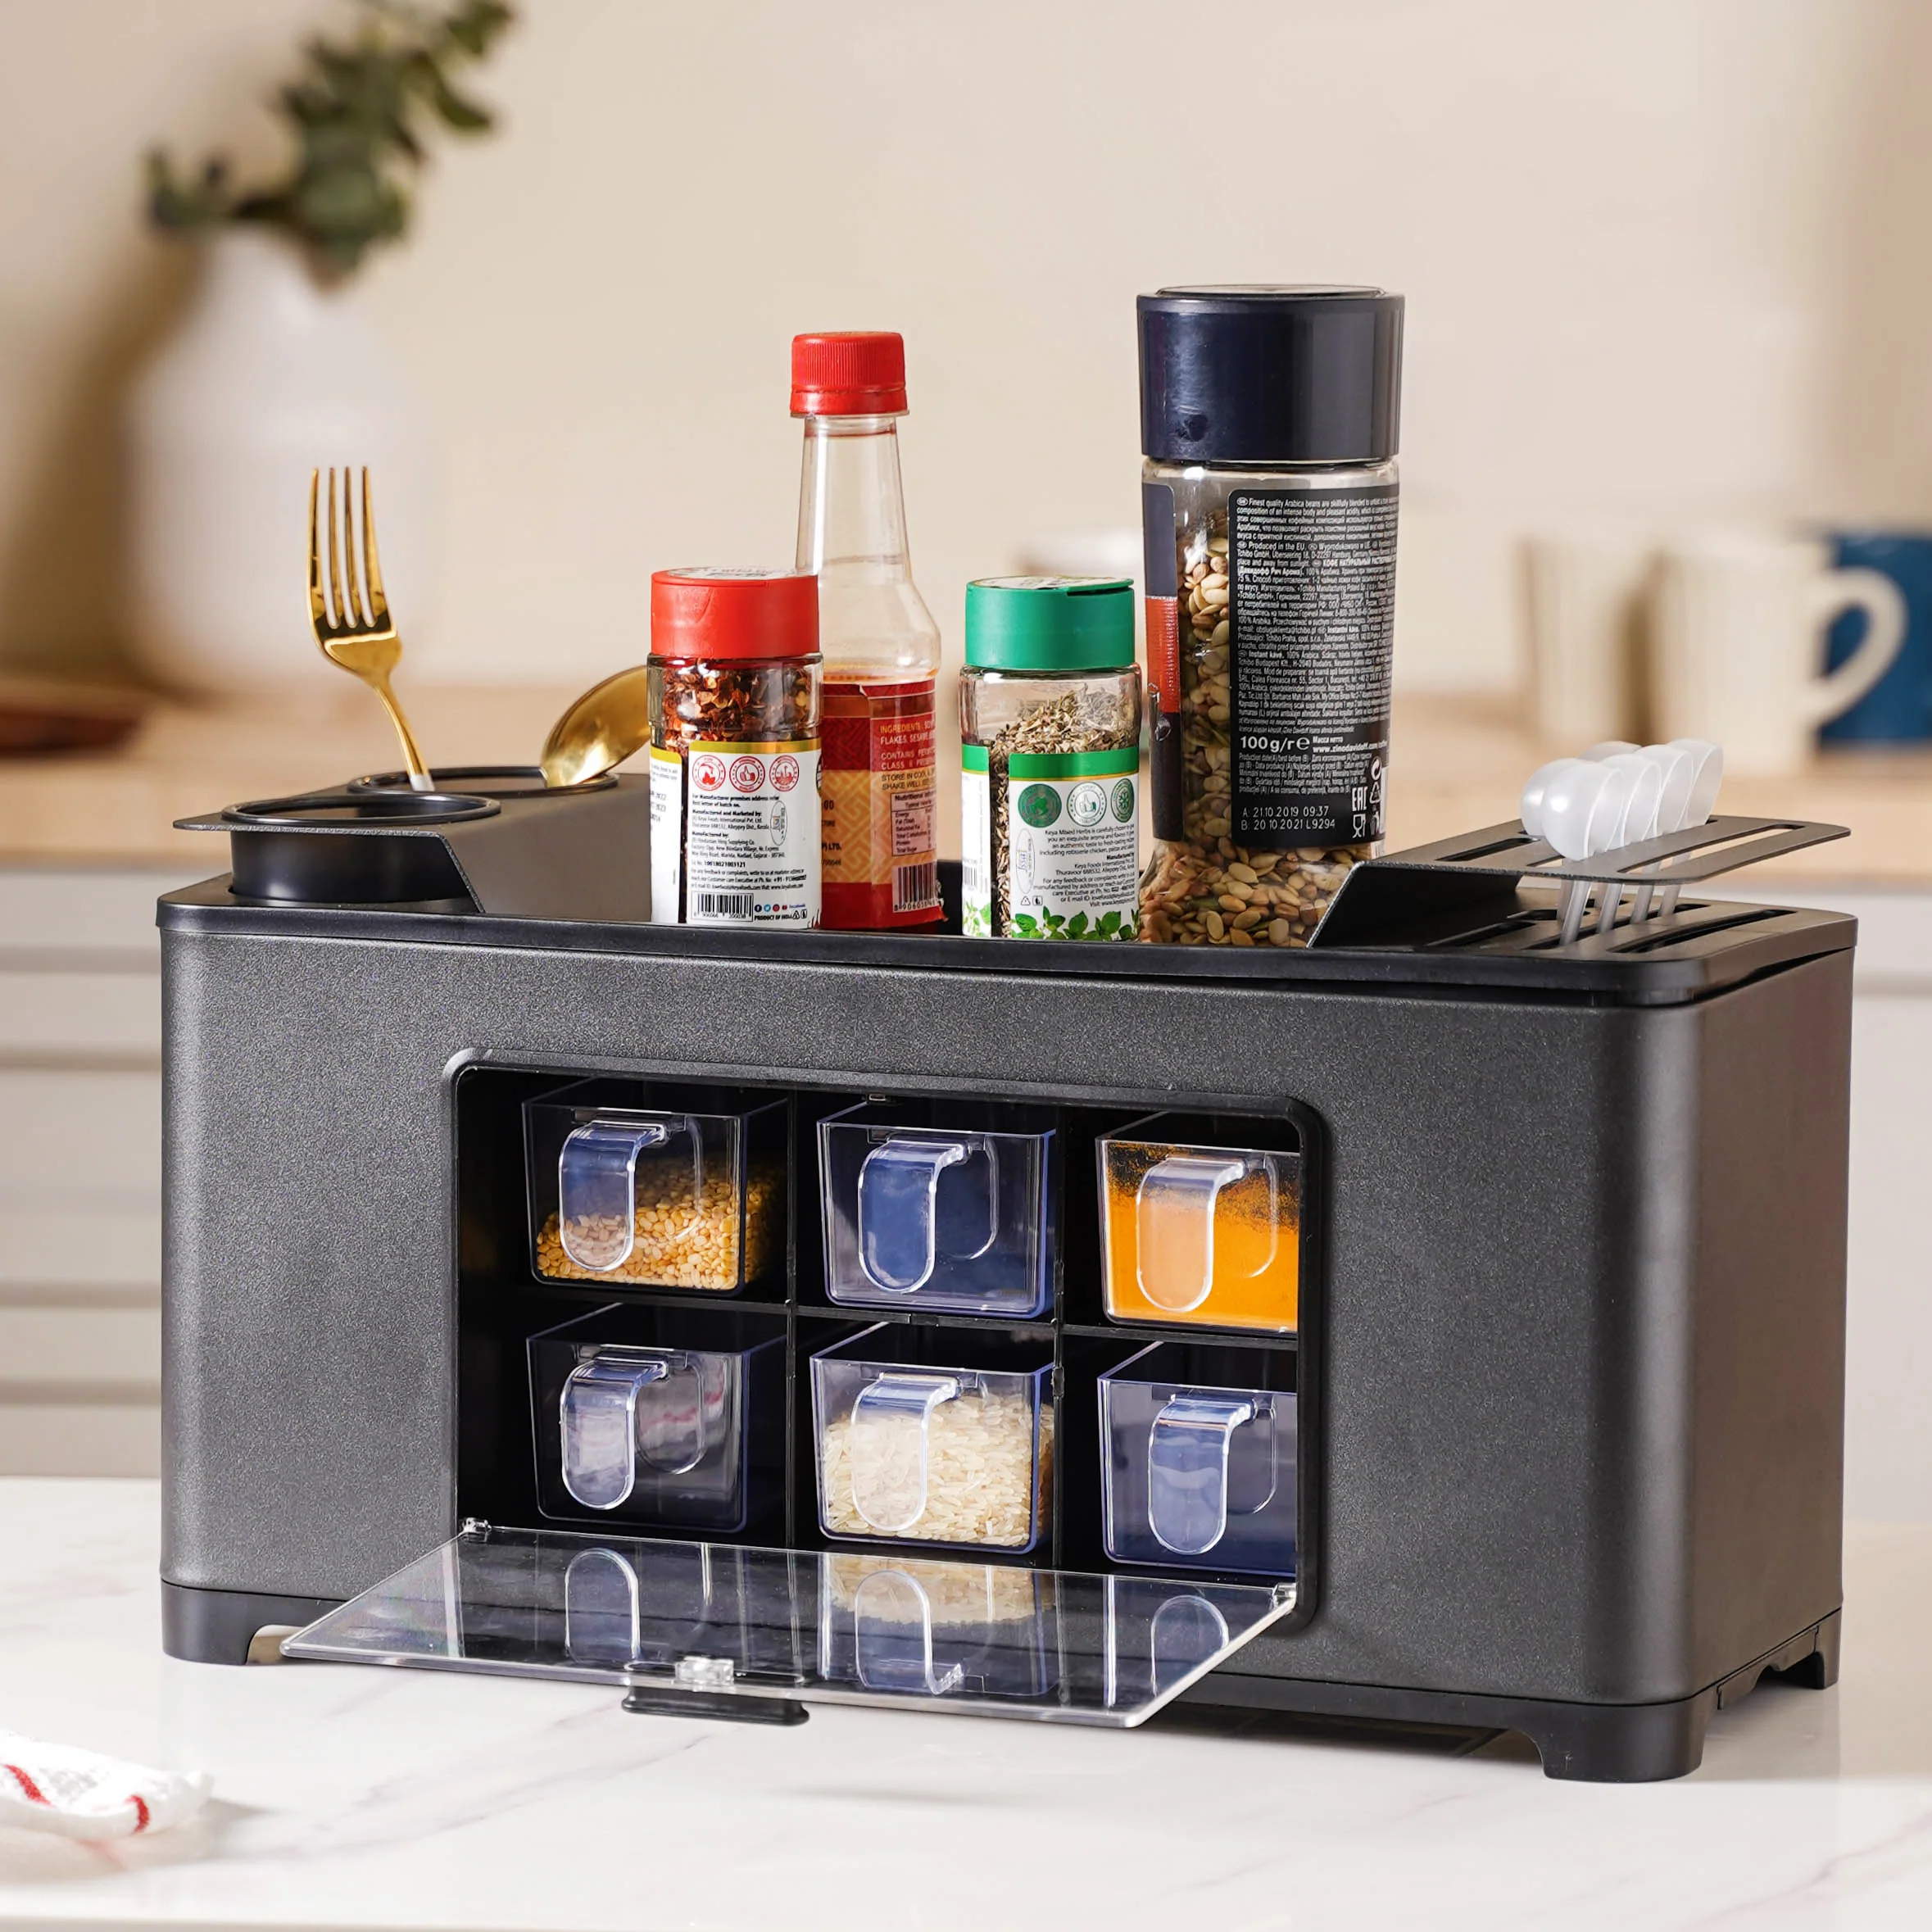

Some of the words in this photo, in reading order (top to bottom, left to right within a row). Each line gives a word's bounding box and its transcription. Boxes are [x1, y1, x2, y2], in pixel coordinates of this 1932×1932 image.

[1249, 542, 1277, 550] Produced
[1237, 549, 1253, 557] Tchibo
[881, 751, 914, 760] CONTAINS
[881, 761, 905, 770] CLASS
[882, 773, 905, 782] STORE
[882, 782, 905, 791] SHAKE
